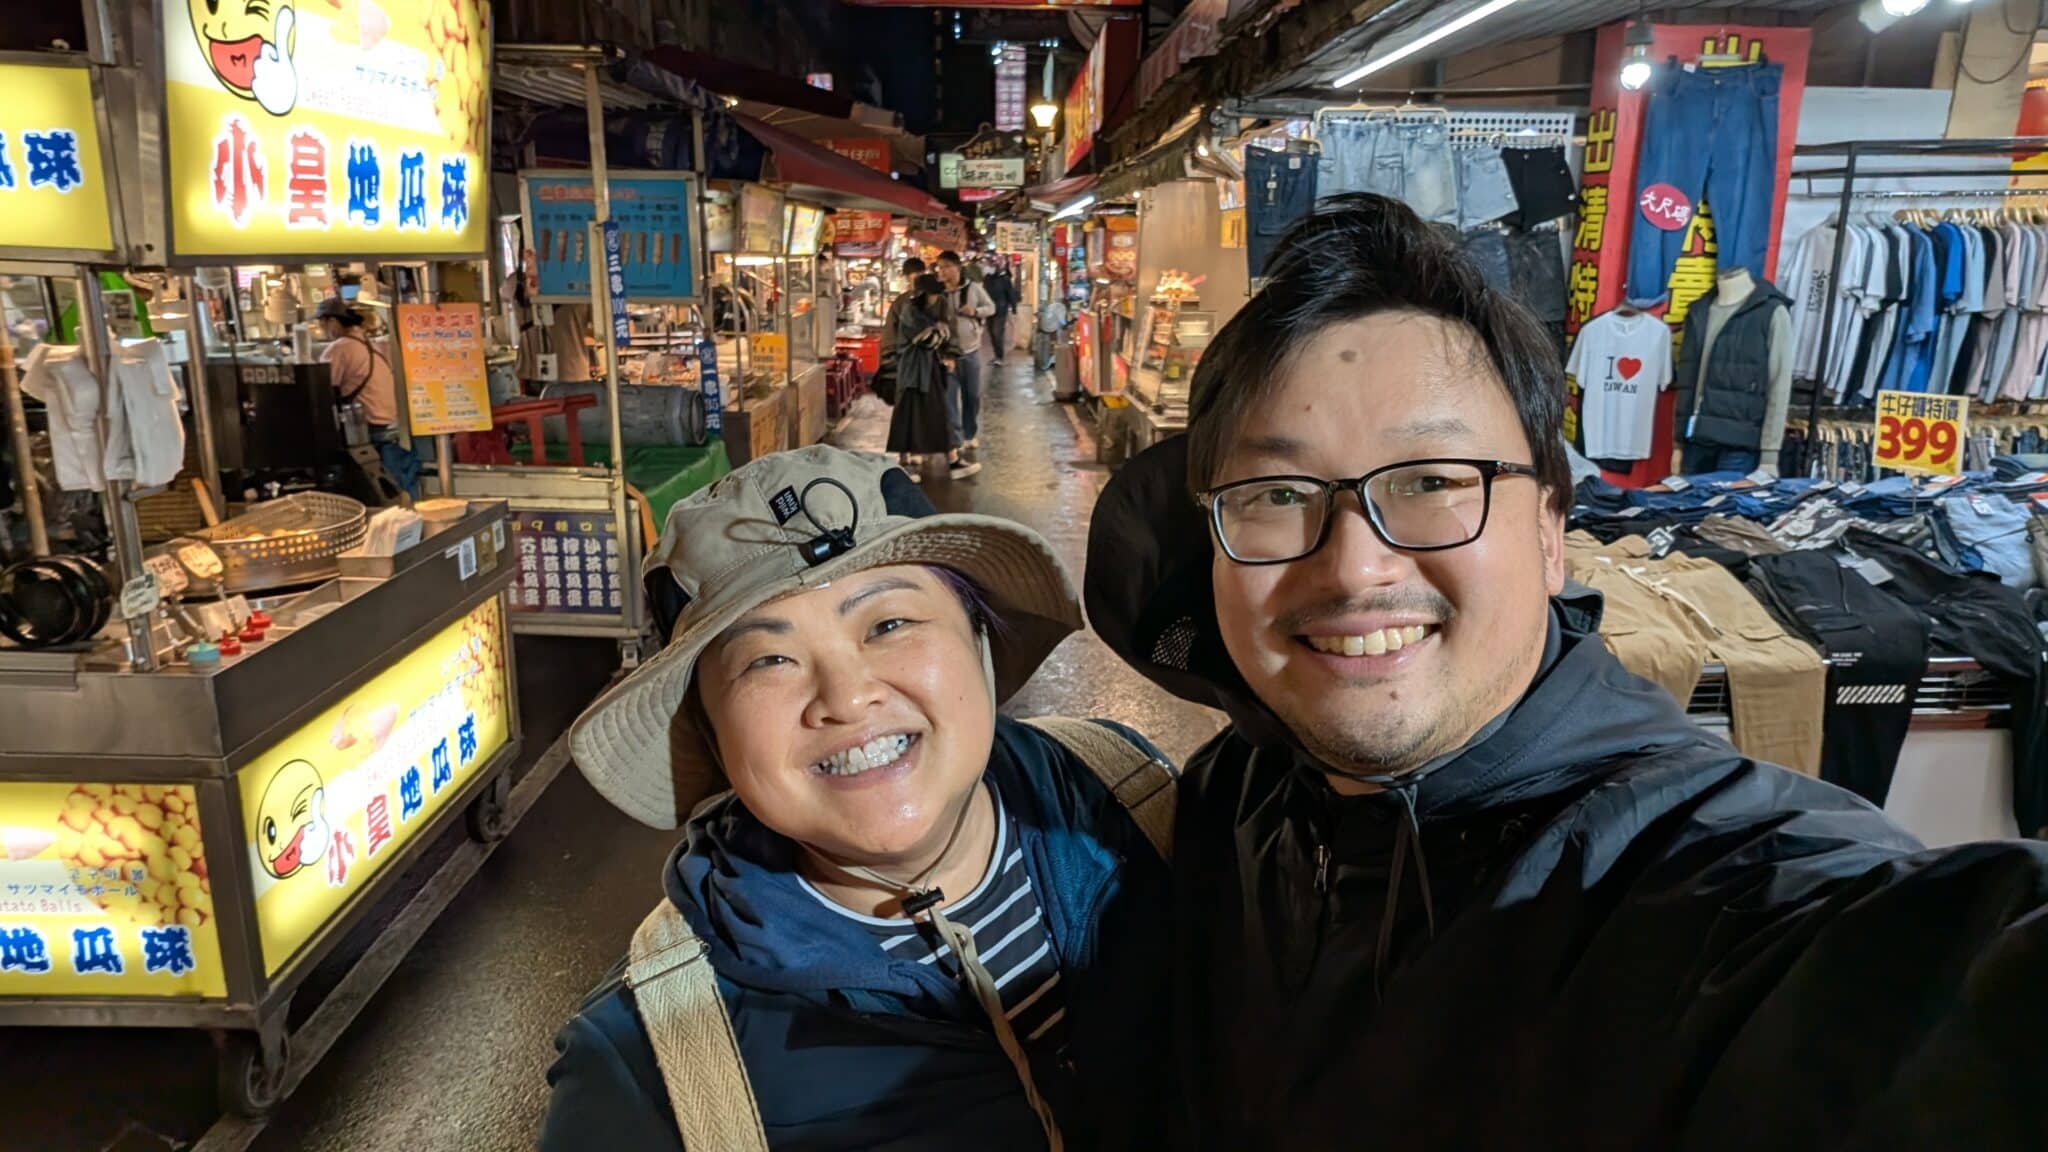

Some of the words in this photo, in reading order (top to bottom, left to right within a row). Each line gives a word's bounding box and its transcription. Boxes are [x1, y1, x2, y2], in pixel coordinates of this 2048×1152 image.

[0, 131, 82, 189] 球
[213, 118, 468, 229] 小皇地瓜球
[1640, 191, 1692, 227] 大尺碼
[1605, 356, 1615, 379] I
[1881, 395, 1959, 421] 牛仔褲特價
[1877, 416, 1958, 465] 399
[328, 712, 477, 884] 小皇地瓜球
[40, 898, 82, 912] Balls
[0, 927, 194, 974] 地瓜球
